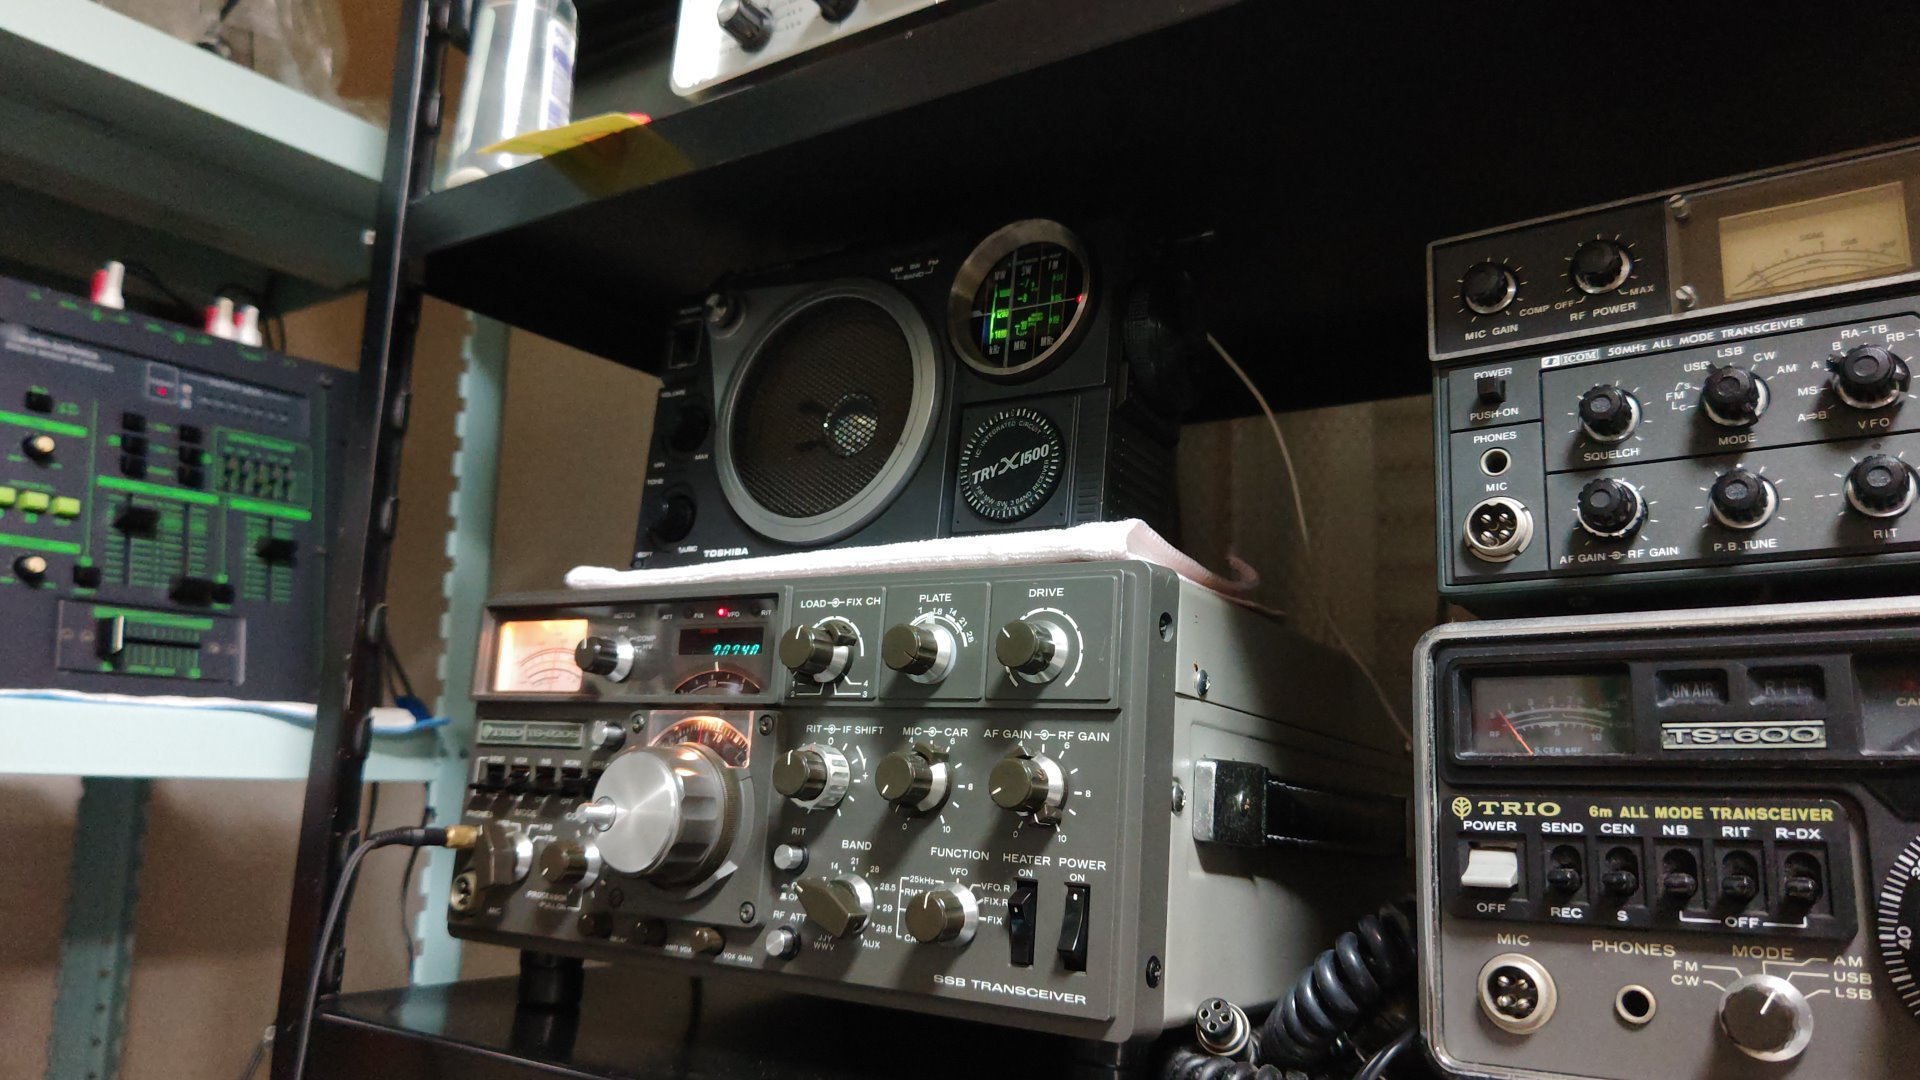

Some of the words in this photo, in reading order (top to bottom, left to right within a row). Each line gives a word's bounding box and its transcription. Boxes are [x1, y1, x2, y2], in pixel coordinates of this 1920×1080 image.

[1628, 284, 1655, 296] MAX
[1519, 304, 1550, 317] COMP
[1554, 299, 1575, 310] OFF
[1569, 311, 1586, 322] RF
[1592, 301, 1638, 318] POWER
[1464, 330, 1487, 342] MIC
[1492, 323, 1519, 337] GAIN
[1840, 324, 1888, 340] RA-TB
[1562, 350, 1598, 366] ICOM
[1607, 343, 1647, 357] 50MHz
[1652, 337, 1674, 350] ALL
[1678, 331, 1716, 346] MODE
[1721, 318, 1805, 339] TRANSCEIVER
[1832, 341, 1841, 351] B
[1716, 346, 1744, 359] LSB
[1753, 351, 1776, 363] CW
[1683, 360, 1711, 373] USB
[1776, 363, 1798, 375] AM
[1810, 361, 1820, 370] A
[1473, 367, 1513, 381] POWER
[1665, 391, 1685, 402] FM
[1797, 386, 1818, 397] MS
[1469, 407, 1520, 421] PUSH-ON
[1857, 417, 1890, 429] VFO
[1473, 430, 1518, 444] PHONES
[1718, 432, 1758, 446] MODE
[1583, 447, 1640, 462] SQUELCH
[1485, 482, 1508, 492] MIC
[1872, 527, 1899, 540] RIT
[703, 547, 749, 558] TOSHIBA
[1559, 554, 1575, 565] AF
[1577, 552, 1606, 564] GAIN
[1627, 548, 1645, 560] RF
[1648, 546, 1680, 558] GAIN
[918, 593, 953, 603] PLATE
[1028, 587, 1065, 598] DRIVE
[800, 599, 827, 609] LOAD
[846, 598, 863, 607] FIX
[865, 596, 881, 606] CH
[727, 610, 740, 618] VFO
[760, 609, 772, 617] RIT
[958, 616, 968, 627] 21
[966, 630, 975, 643] 28
[863, 680, 869, 688] 4
[1671, 686, 1690, 699] ON
[1691, 682, 1714, 698] AIR
[806, 725, 823, 733] RIT
[842, 725, 852, 734] IF
[854, 726, 885, 735] SHIFT
[902, 727, 922, 736] MIC
[944, 727, 968, 737] CAR
[983, 729, 999, 738] AF
[1002, 729, 1032, 739] GAIN
[1058, 731, 1075, 740] RF
[1078, 732, 1110, 742] GAIN
[1666, 726, 1821, 744] TS-600
[827, 737, 834, 745] 0
[950, 737, 956, 745] 6
[1085, 790, 1091, 798] 8
[1477, 801, 1561, 817] TRIO
[1588, 805, 1612, 818] 6m
[1619, 806, 1649, 819] ALL
[1654, 806, 1704, 820] MODE
[1710, 807, 1834, 822] TRANSCEIVER
[791, 827, 807, 836] RIT
[942, 825, 951, 834] 10
[1463, 821, 1518, 832] POWER
[1541, 822, 1584, 833] SEND
[1600, 823, 1635, 835] CEN
[1662, 825, 1689, 836] NB
[1722, 826, 1751, 838] RIT
[1058, 835, 1067, 843] 10
[1775, 827, 1822, 840] R-DX
[841, 839, 872, 850] BAND
[930, 846, 990, 861] FUNCTION
[1002, 852, 1051, 866] HEATER
[830, 861, 839, 870] 14
[850, 857, 859, 866] 21
[1058, 857, 1107, 871] POWER
[869, 865, 880, 873] 28
[949, 867, 969, 876] VFO
[1018, 869, 1034, 877] ON
[909, 875, 935, 885] 25kHz
[1069, 873, 1085, 882] ON
[879, 882, 896, 892] 28.5
[882, 903, 893, 912] 29
[1476, 902, 1507, 913] OFF
[1550, 906, 1583, 919] REC
[772, 910, 785, 919] RF
[789, 912, 807, 922] ATT
[987, 916, 1003, 925] FIX
[1617, 910, 1628, 922] S
[1724, 916, 1760, 929] OFF
[904, 934, 919, 943] CA
[1496, 933, 1531, 947] MIC
[1896, 925, 1912, 950] 40
[862, 939, 881, 949] AUX
[1591, 939, 1676, 957] PHONES
[723, 951, 736, 960] VOX
[737, 954, 754, 963] GAIN
[1732, 944, 1795, 961] MODE
[1673, 959, 1698, 972] FM
[1833, 956, 1863, 967] AM
[1671, 974, 1700, 986] CW
[1833, 971, 1873, 985] USB
[933, 974, 966, 988] SSB
[971, 979, 1087, 1005] TRANSCEIVER
[1835, 986, 1873, 1000] LSB
